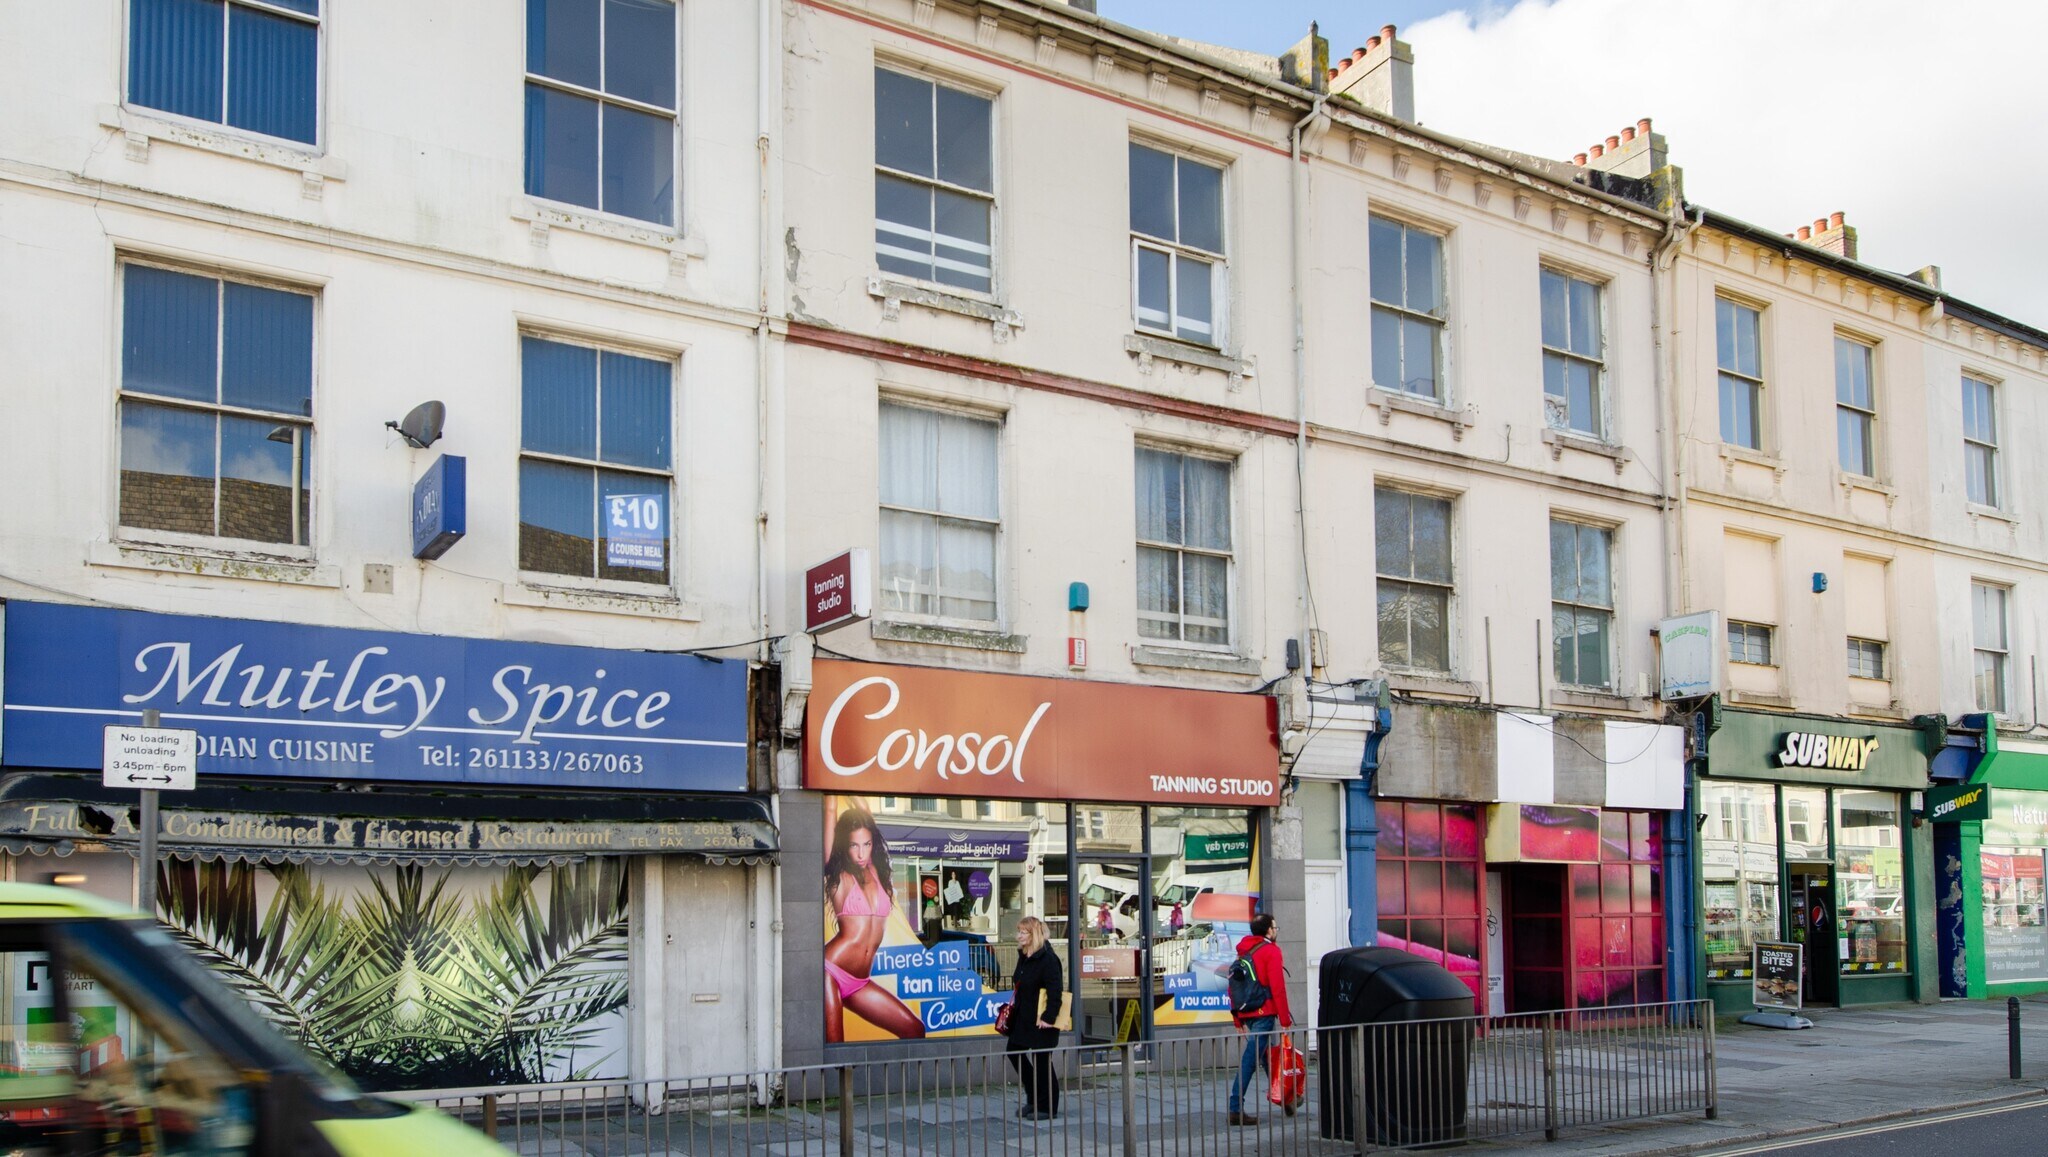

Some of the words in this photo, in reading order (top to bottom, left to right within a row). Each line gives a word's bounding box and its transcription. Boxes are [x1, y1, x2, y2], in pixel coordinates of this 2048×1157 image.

[612, 497, 659, 530] £10
[609, 542, 615, 554] 4
[615, 543, 643, 557] COURSE
[644, 545, 662, 558] MEAL
[814, 573, 844, 595] tanning
[817, 591, 842, 613] studio
[123, 641, 446, 739] Mutley
[468, 665, 671, 745] Spice
[121, 733, 136, 743] No
[140, 734, 180, 746] loading
[819, 676, 1052, 783] Consol
[124, 746, 176, 758] unloading
[197, 735, 257, 759] DIAN
[268, 738, 374, 764] CUISINE
[418, 745, 461, 768] Tel:
[468, 748, 644, 774] 261133/267063
[1779, 731, 1880, 770] SUBWAY
[1149, 775, 1217, 795] TANNING
[1220, 778, 1273, 796] STUDIO
[1932, 788, 1983, 817] SUBWAY
[166, 812, 324, 842] Conditioned
[335, 820, 352, 842] &
[364, 820, 469, 845] Licensed
[479, 823, 612, 848] Restaurant
[694, 825, 732, 836] 261133
[630, 837, 651, 847] TEL
[704, 837, 754, 847] 267063
[875, 948, 934, 971] There's
[939, 949, 960, 965] no
[1761, 950, 1794, 958] TOASTED
[1761, 956, 1794, 967] BITES
[74, 981, 94, 991] ART
[903, 975, 933, 993] tan
[938, 975, 962, 992] like
[965, 977, 975, 992] a
[1169, 978, 1176, 988] A
[1177, 977, 1192, 987] tan
[1180, 996, 1200, 1009] you
[1201, 995, 1220, 1006] can
[926, 997, 982, 1029] Consol
